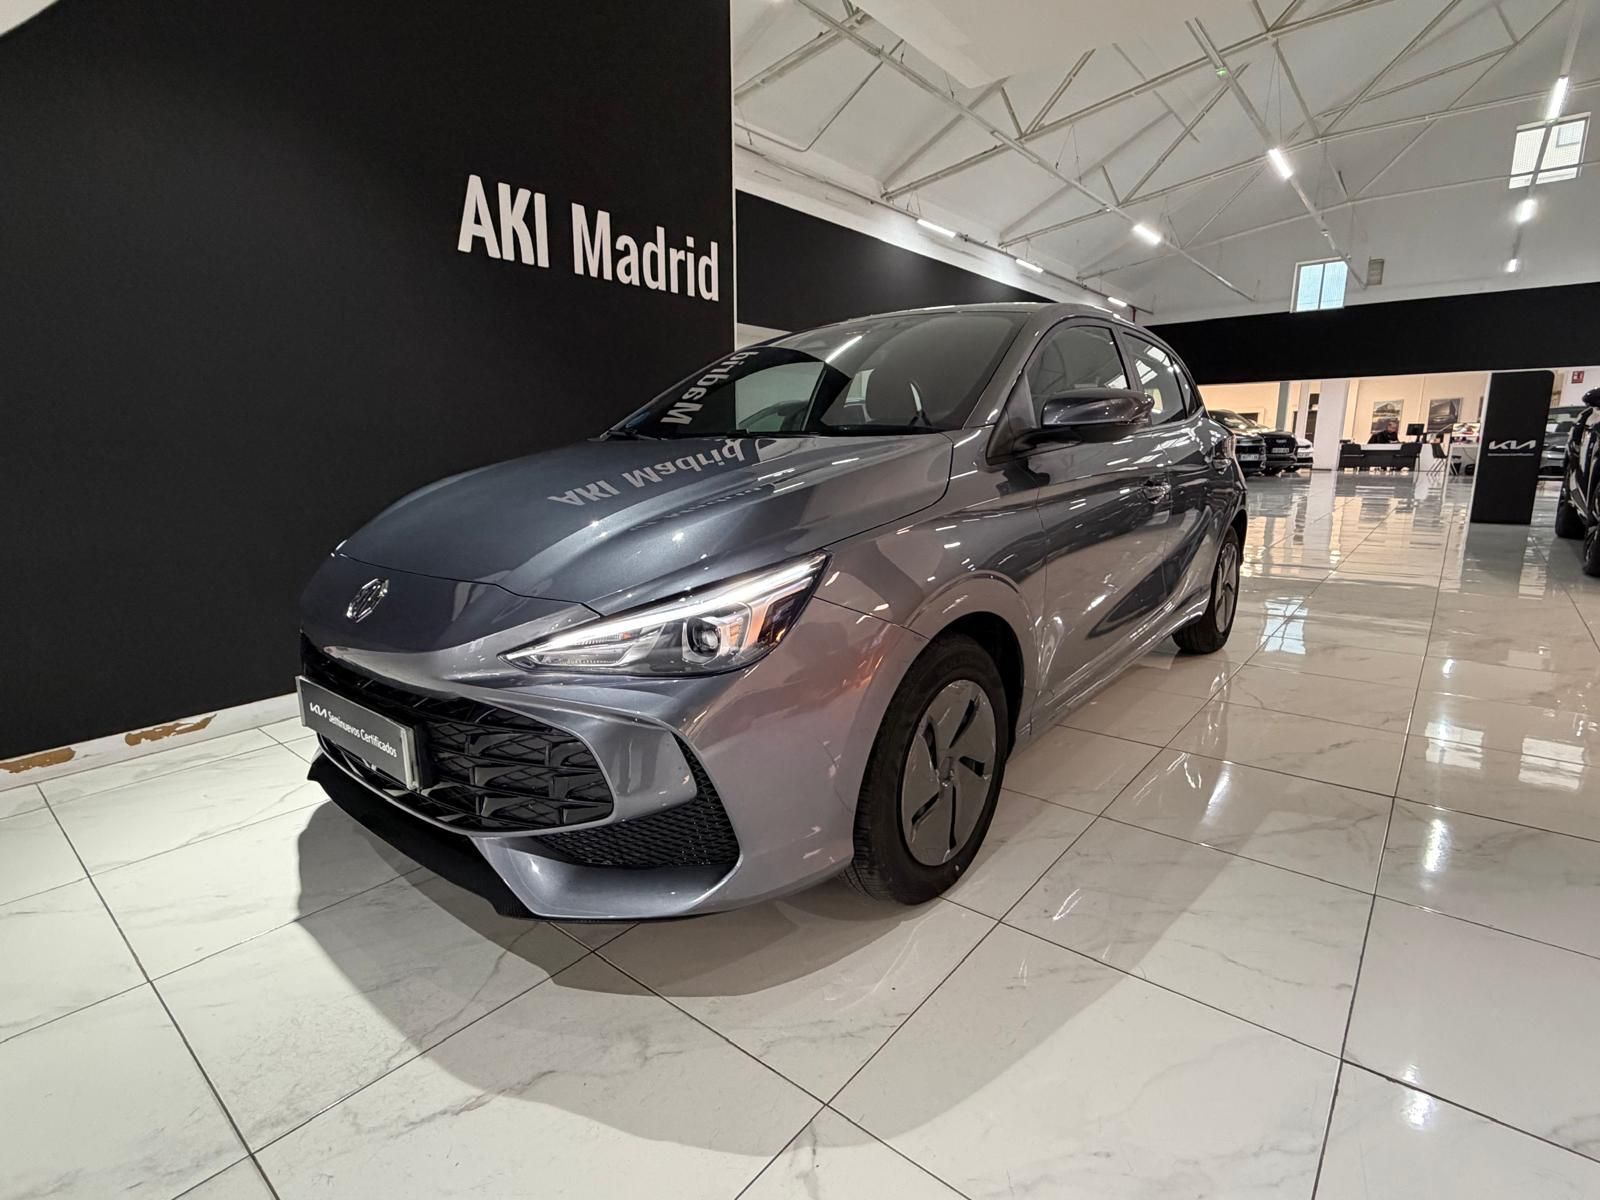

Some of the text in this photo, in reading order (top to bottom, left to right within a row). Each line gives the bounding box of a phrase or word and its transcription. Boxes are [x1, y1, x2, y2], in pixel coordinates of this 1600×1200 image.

[457, 174, 719, 302] AKI Madrid
[328, 710, 361, 738] Seminuevos
[360, 729, 398, 758] Certificados
